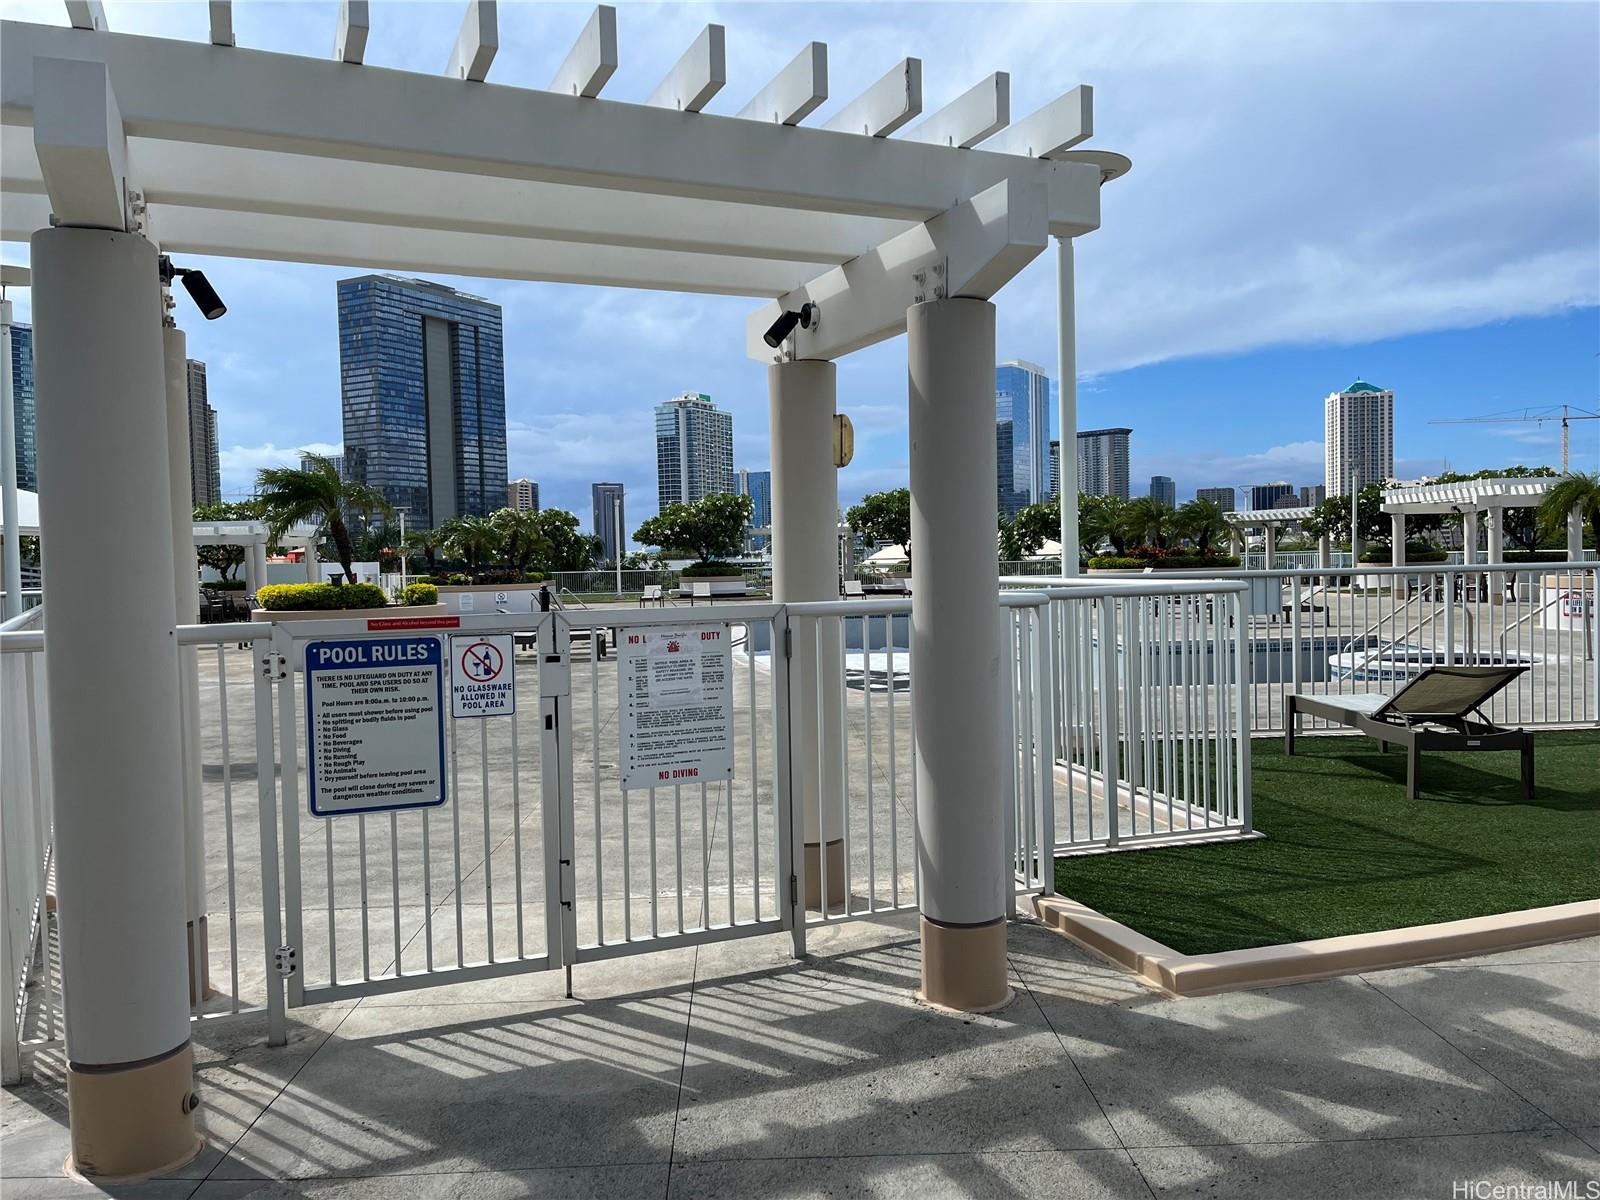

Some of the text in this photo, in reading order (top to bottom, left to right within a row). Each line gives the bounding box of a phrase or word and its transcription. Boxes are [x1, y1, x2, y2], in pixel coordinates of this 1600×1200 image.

[628, 635, 640, 644] NO
[701, 632, 720, 640] DUTY
[320, 644, 428, 664] POOL RULES
[467, 683, 512, 692] GLASSWARE
[460, 692, 496, 701] ALLOWED
[335, 774, 358, 782] yourself
[658, 768, 698, 780] NO DIVING
